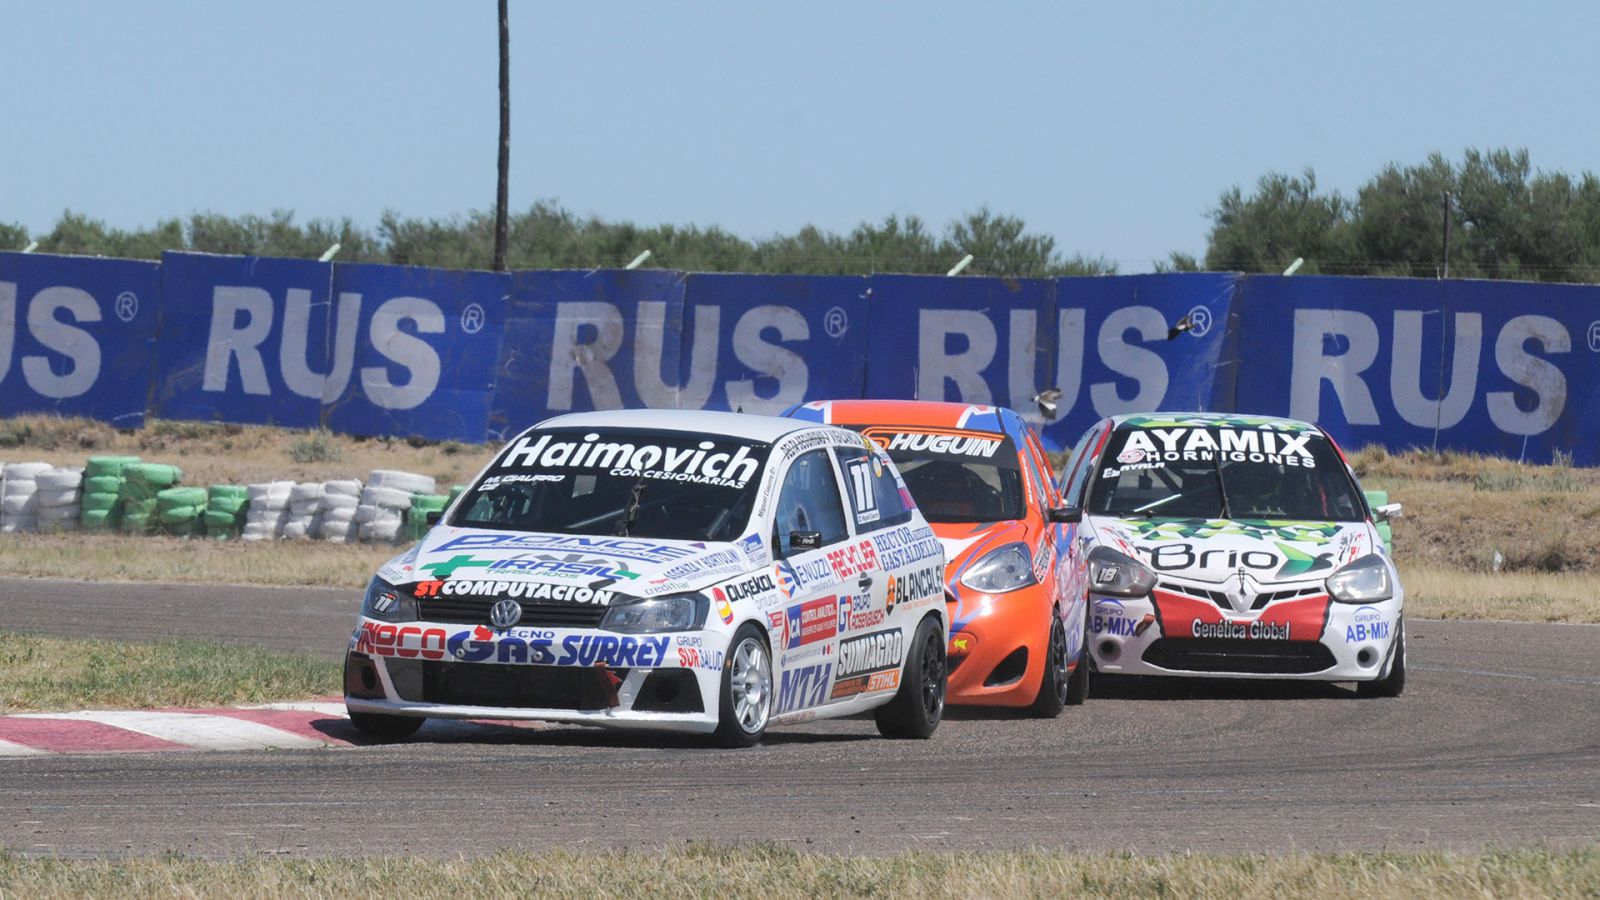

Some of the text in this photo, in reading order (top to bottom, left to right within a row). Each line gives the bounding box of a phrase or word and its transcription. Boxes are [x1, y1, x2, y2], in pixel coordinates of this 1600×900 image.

[203, 285, 446, 409] RUS
[547, 300, 810, 410] RUS
[918, 305, 1169, 425] RUS
[1289, 308, 1572, 436] RUS
[501, 433, 759, 482] Haimovich
[1124, 427, 1314, 458] AYAMIX
[1146, 449, 1316, 469] HORMIGONES
[609, 468, 746, 489] CONCESIONARIAS
[850, 463, 873, 511] 11
[427, 534, 697, 557] PONCE
[873, 526, 913, 552] HECTOR
[826, 539, 882, 582] RECYCLER
[880, 538, 942, 572] GASTALDELLO
[1095, 606, 1123, 616] GRUPO
[1355, 614, 1381, 622] GRUPO
[496, 629, 555, 639] TECNO
[677, 636, 702, 647] GRUPO
[1192, 617, 1290, 640] Genética Global
[558, 635, 670, 666] SURREY
[838, 631, 902, 675] SUMIAGRO
[868, 671, 897, 690] STIHL
